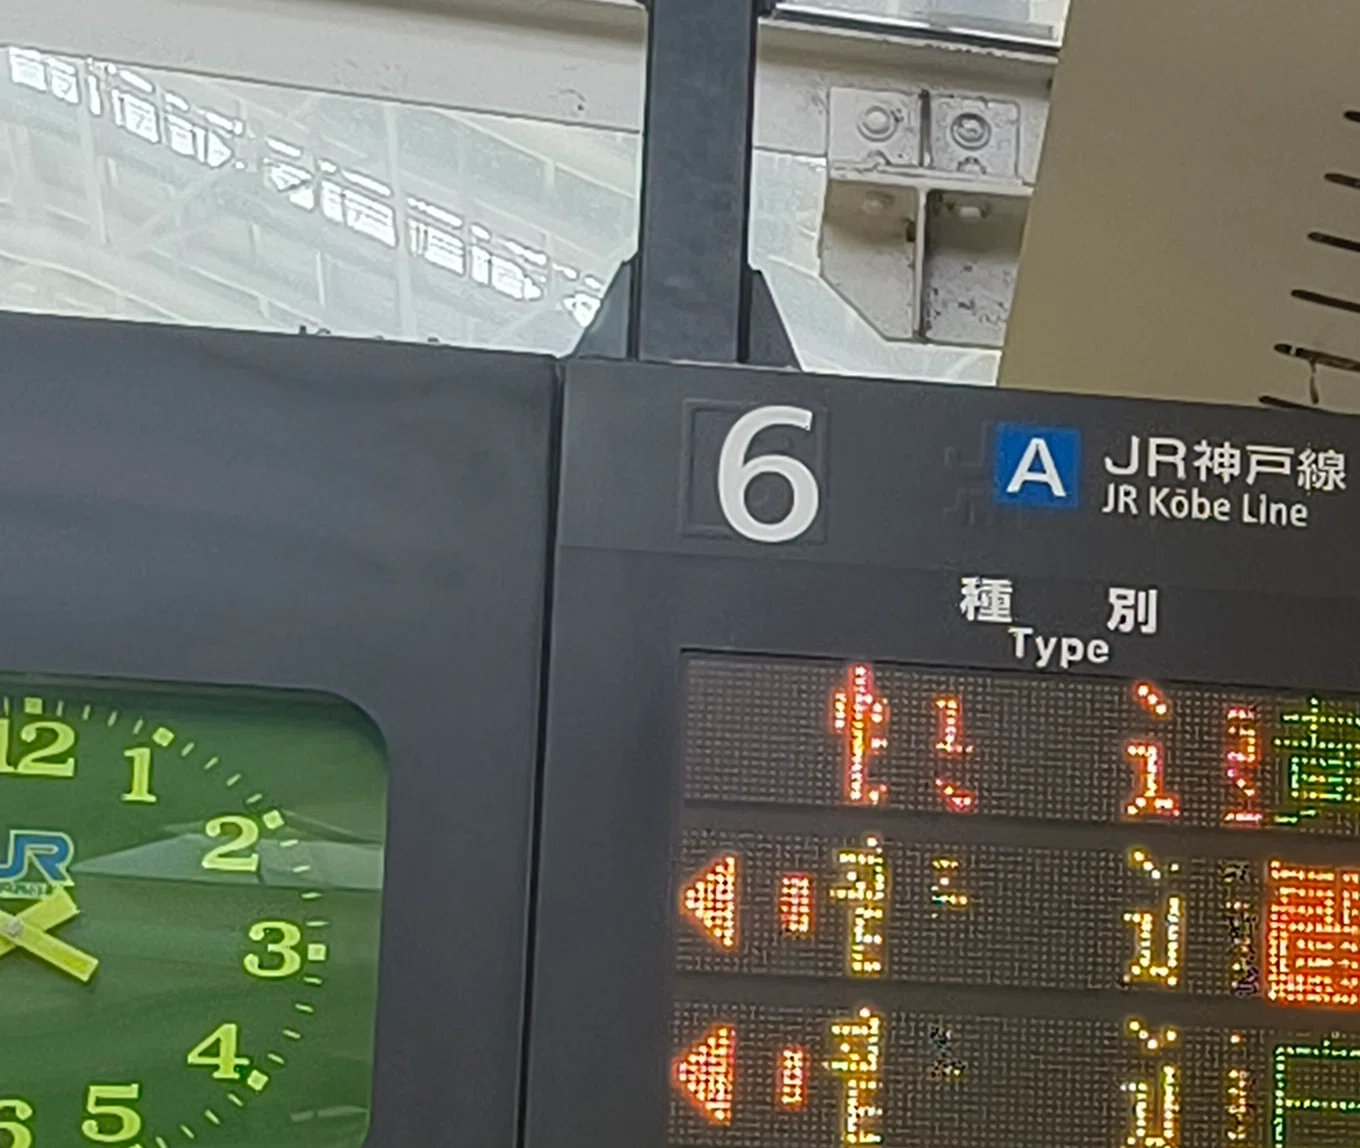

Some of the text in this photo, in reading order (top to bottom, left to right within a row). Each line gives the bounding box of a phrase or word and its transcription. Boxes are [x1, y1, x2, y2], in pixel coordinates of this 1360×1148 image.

[717, 405, 821, 543] 6
[1005, 436, 1067, 498] A
[1105, 434, 1348, 494] JR神戸線
[1103, 483, 1139, 516] JR
[1240, 494, 1309, 528] Line
[1009, 626, 1110, 670] Type
[121, 747, 157, 803] 1
[201, 815, 260, 872] 2
[244, 921, 302, 978] 3
[187, 1023, 250, 1080] 4
[82, 1082, 142, 1142] 5
